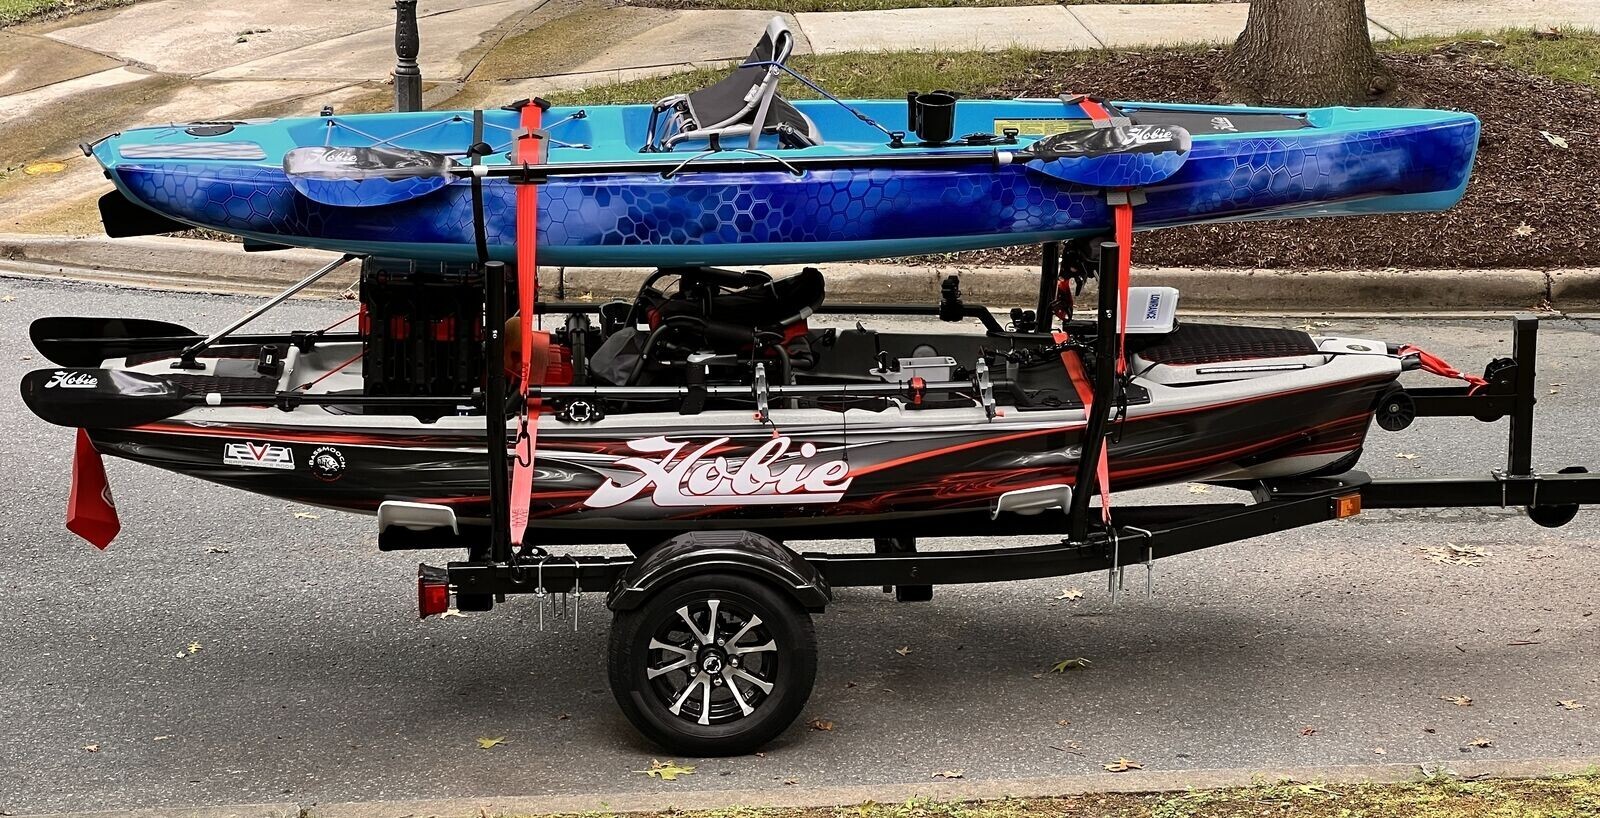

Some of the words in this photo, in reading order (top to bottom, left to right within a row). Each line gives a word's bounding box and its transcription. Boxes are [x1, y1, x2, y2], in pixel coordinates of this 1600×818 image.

[1121, 126, 1173, 146] Hobie
[1146, 294, 1161, 320] LOWRANCE
[44, 370, 98, 389] Hobie
[224, 442, 294, 463] LEVEL
[308, 446, 346, 468] BASSMOOCH
[583, 436, 853, 508] Hobie
